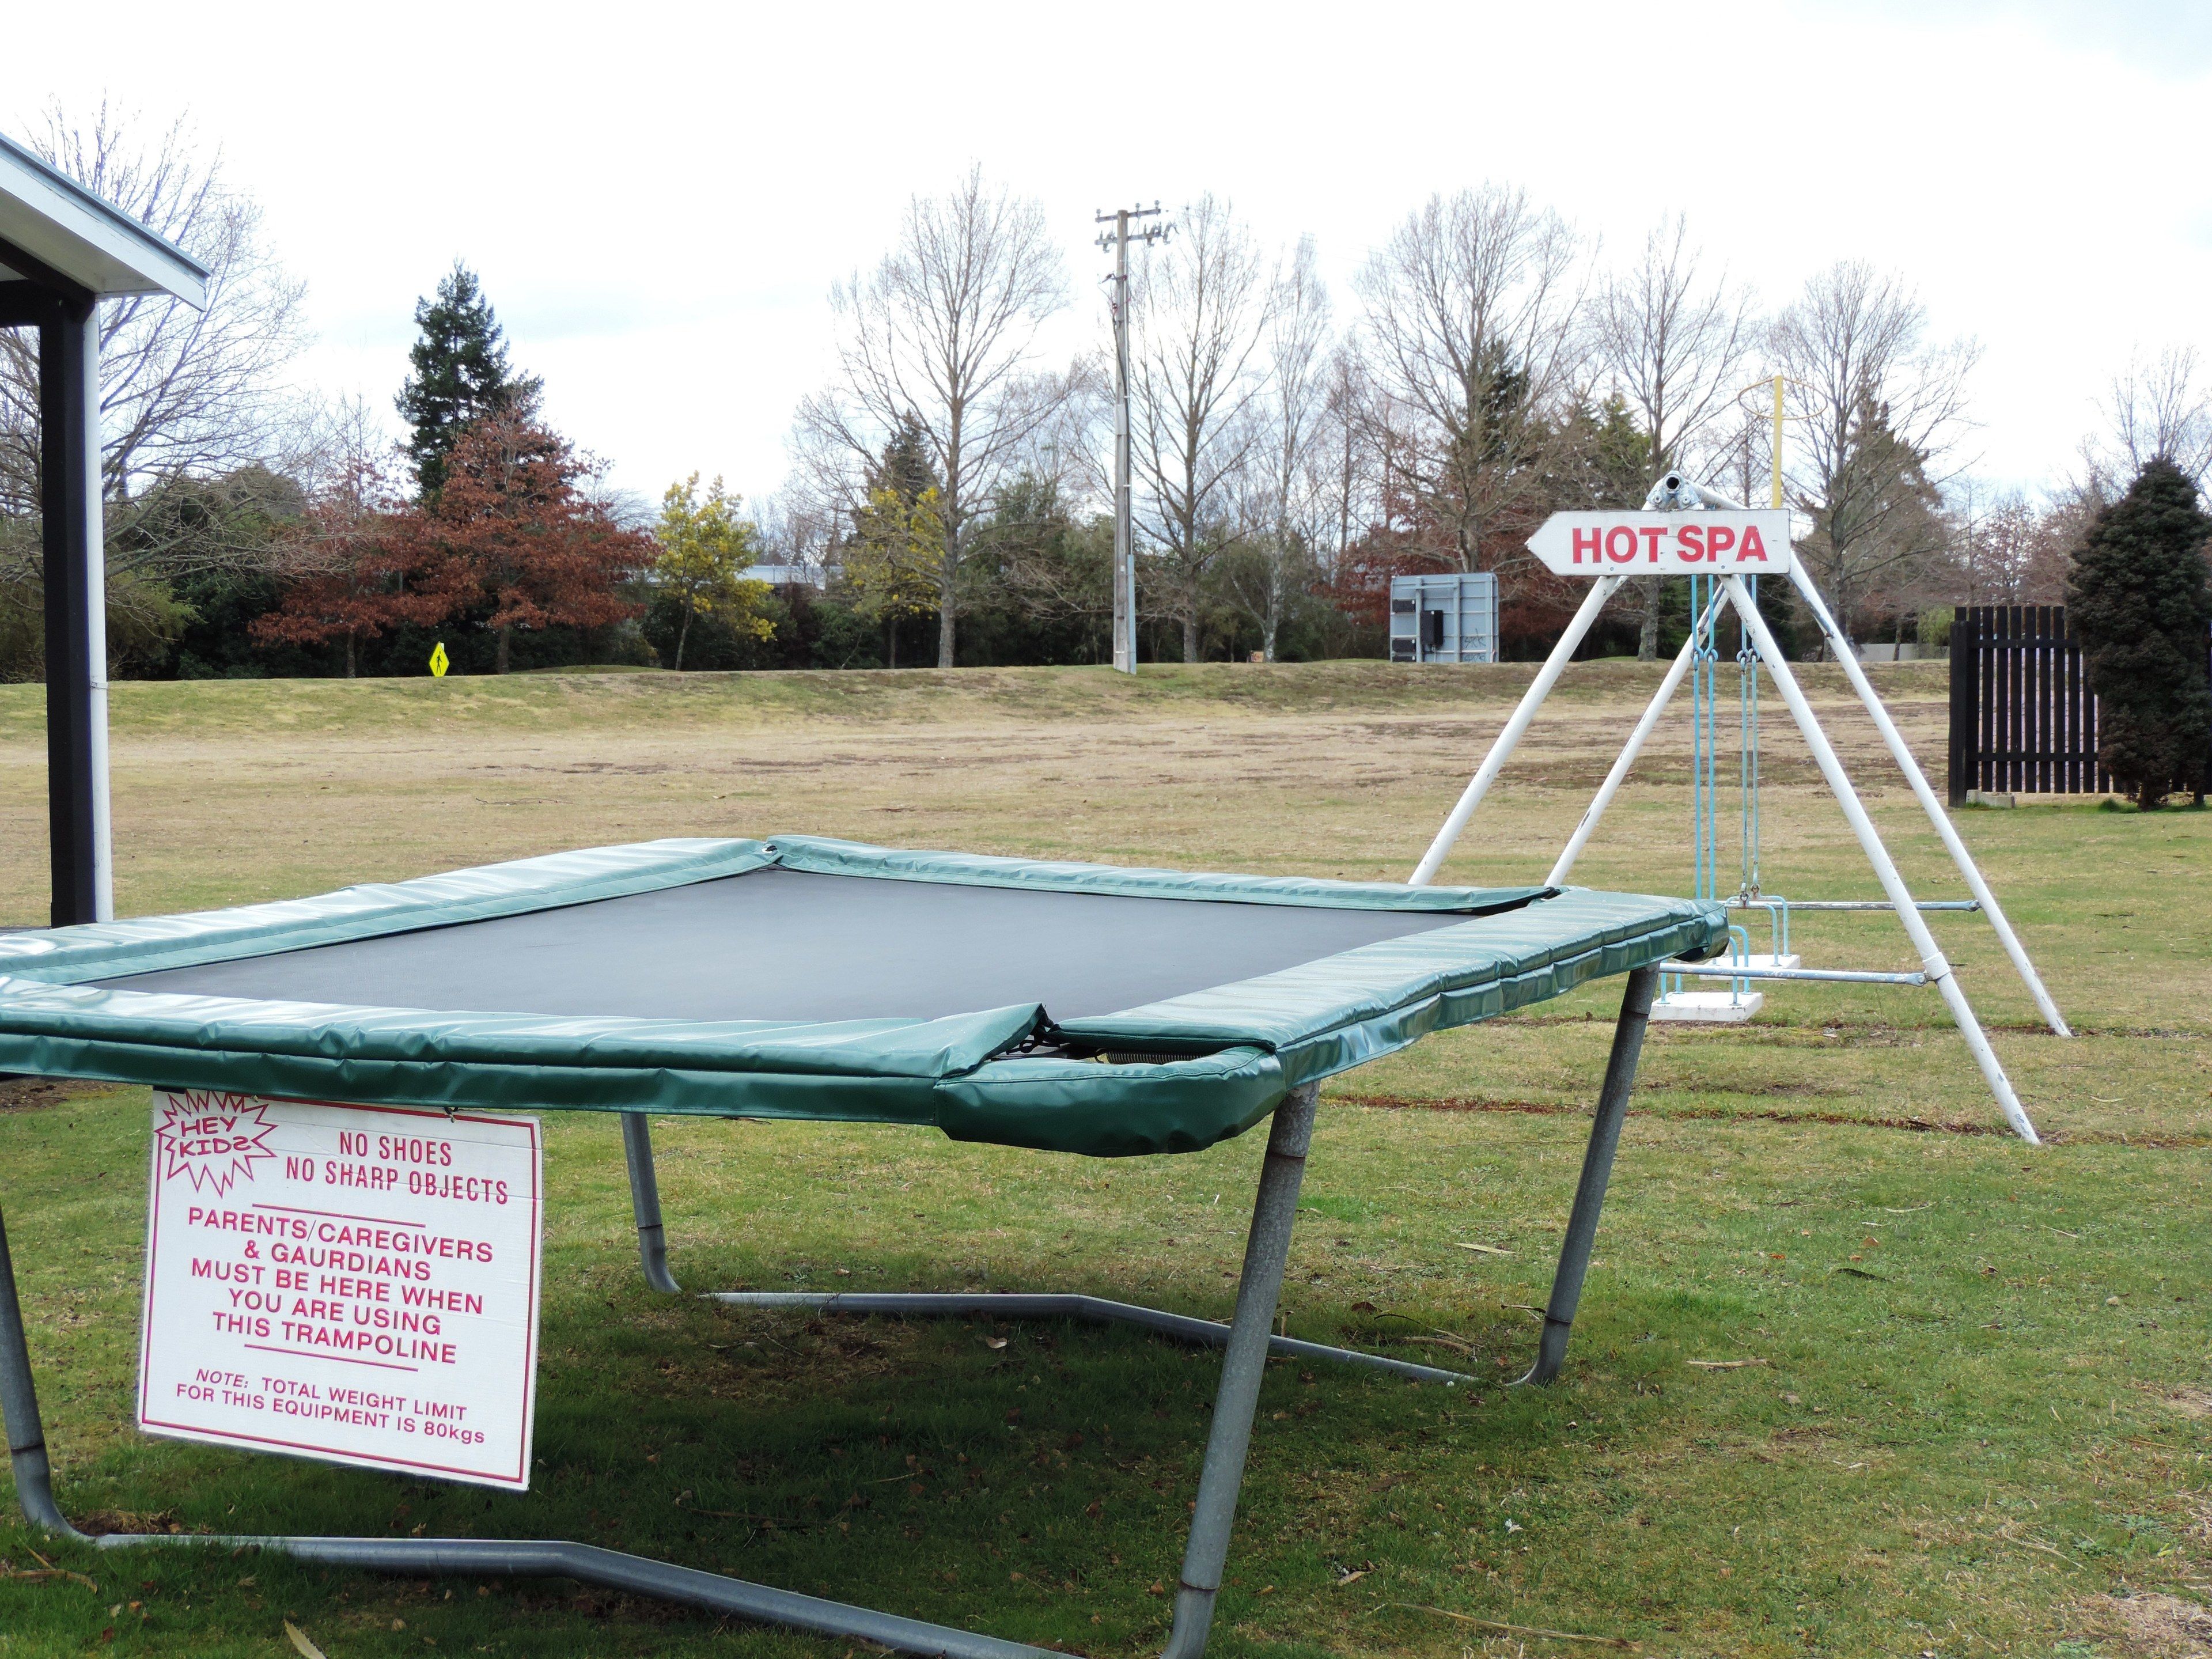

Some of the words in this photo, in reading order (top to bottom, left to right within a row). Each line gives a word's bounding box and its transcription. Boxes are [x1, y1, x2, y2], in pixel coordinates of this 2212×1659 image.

[1572, 525, 1668, 564] HOT
[1677, 525, 1768, 563] SPA
[180, 1116, 238, 1137] HEY
[339, 1131, 368, 1157] NO
[378, 1136, 452, 1167] SHOES
[286, 1156, 315, 1183] NO
[325, 1160, 399, 1191] SHARP
[408, 1170, 508, 1206] OBJECTS
[188, 1206, 494, 1263] PARENTS/CAREGIVERS
[244, 1238, 260, 1260] &
[271, 1243, 431, 1282] GAURDIANS
[191, 1257, 266, 1285] MUST
[275, 1268, 309, 1292] BE
[319, 1276, 391, 1302] HERE
[400, 1285, 484, 1316] WHEN
[228, 1288, 282, 1313] YOU
[291, 1298, 344, 1323] ARE
[353, 1305, 442, 1336] USING
[212, 1311, 271, 1338] THIS
[281, 1320, 457, 1365] TRAMPOLINE
[176, 1383, 215, 1401] FOR
[222, 1389, 265, 1410] THIS
[272, 1397, 390, 1431] EQUIPMENT
[397, 1417, 416, 1433] IS
[423, 1421, 485, 1445] 80kgs
[196, 1369, 250, 1389] NOTE:
[262, 1377, 321, 1400] TOTAL
[328, 1388, 407, 1412] WEIGHT
[414, 1403, 468, 1422] LIMIT
